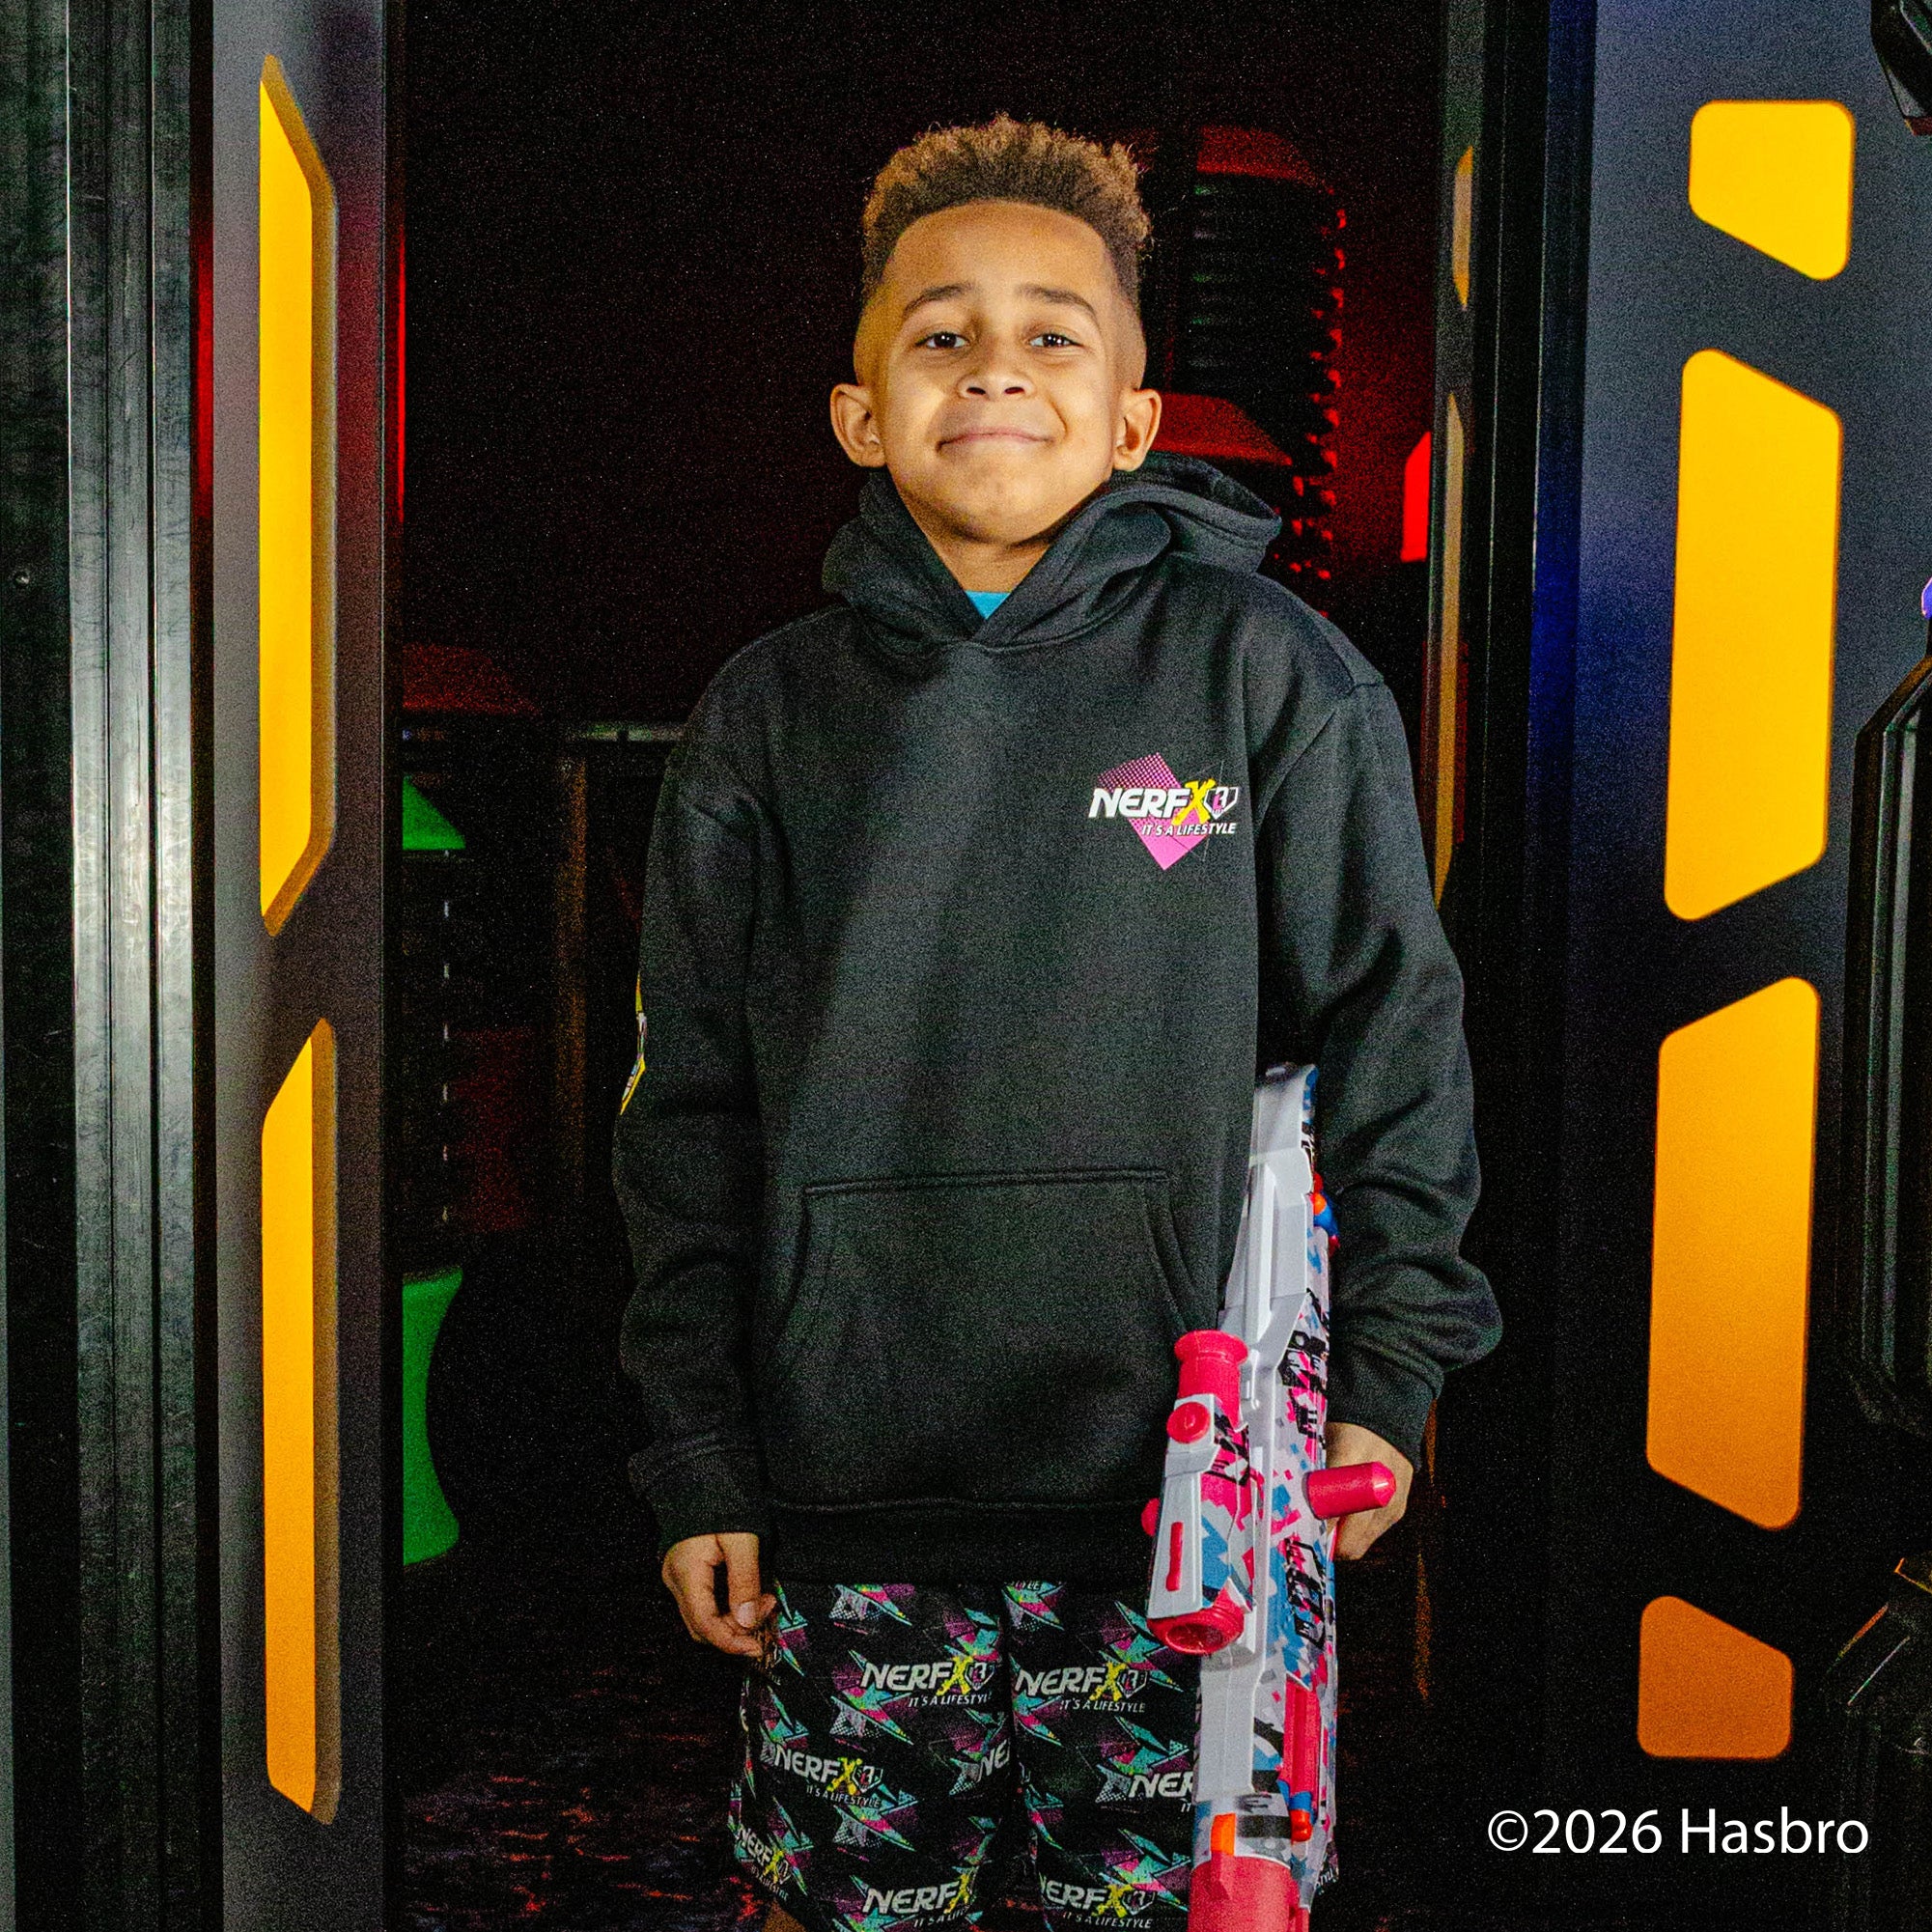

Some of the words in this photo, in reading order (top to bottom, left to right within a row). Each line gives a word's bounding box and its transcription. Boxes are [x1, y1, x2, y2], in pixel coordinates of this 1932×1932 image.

[1164, 825, 1174, 836] A
[1176, 823, 1237, 836] LIFESTYLE
[929, 1696, 938, 1706] A
[1082, 1700, 1092, 1710] A
[1094, 1700, 1146, 1713] LIFESTYLE
[830, 1792, 881, 1808] LIFESTYLE
[1095, 1917, 1153, 1928] LIFESTYLE
